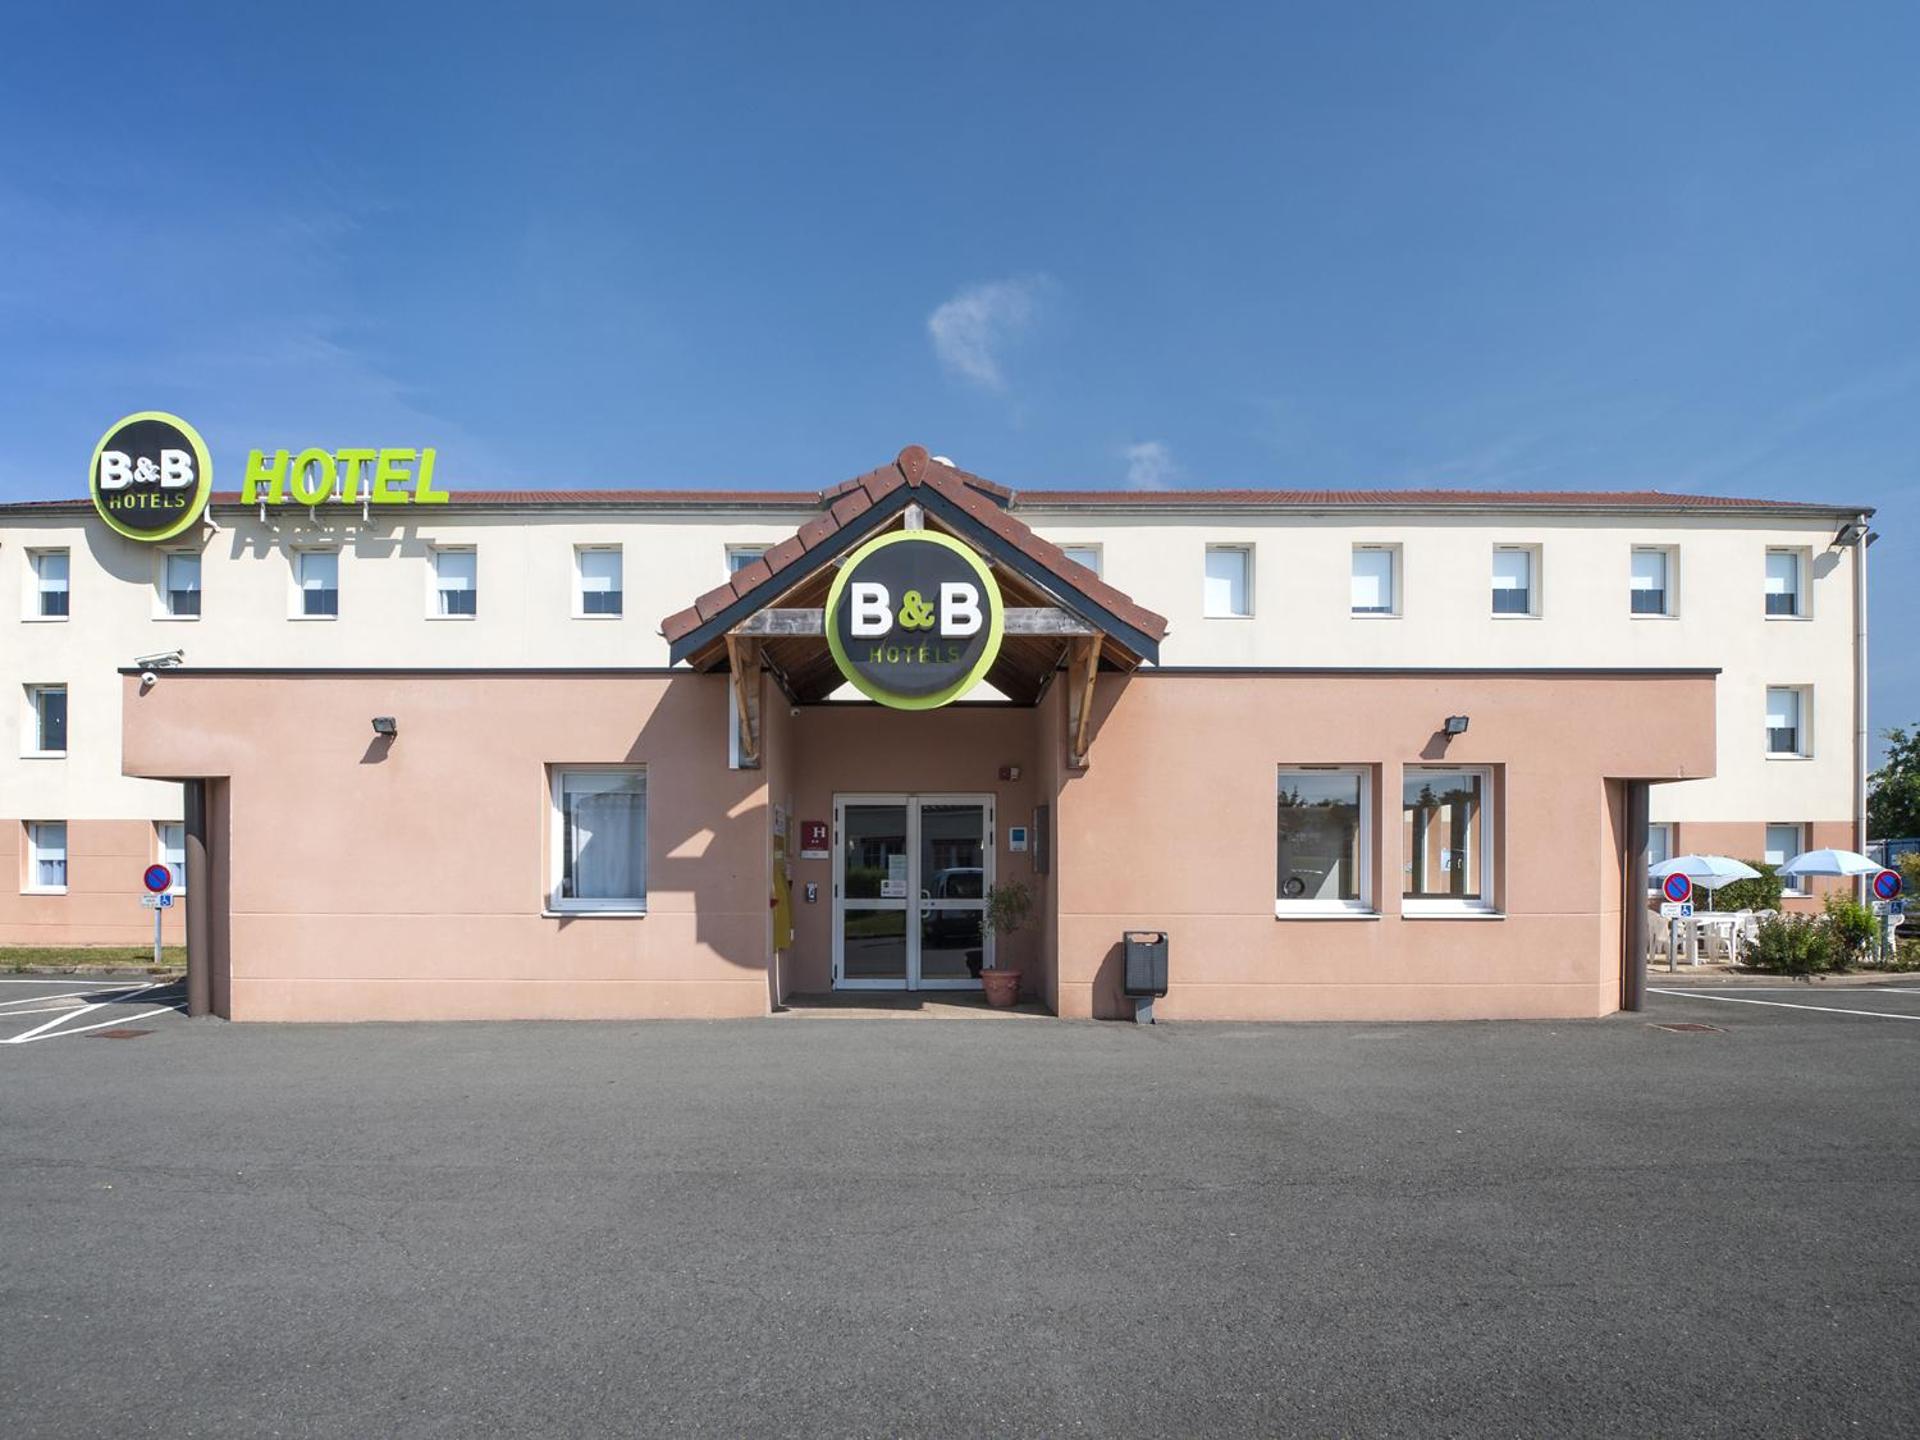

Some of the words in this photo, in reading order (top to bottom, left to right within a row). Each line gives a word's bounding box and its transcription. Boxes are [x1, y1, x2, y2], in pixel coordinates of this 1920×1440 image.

[100, 449, 194, 489] B&B
[241, 448, 449, 506] HOTEL
[109, 493, 186, 509] HOTELS
[851, 582, 982, 637] B&B
[870, 646, 959, 664] HOTELS
[813, 826, 827, 839] H
